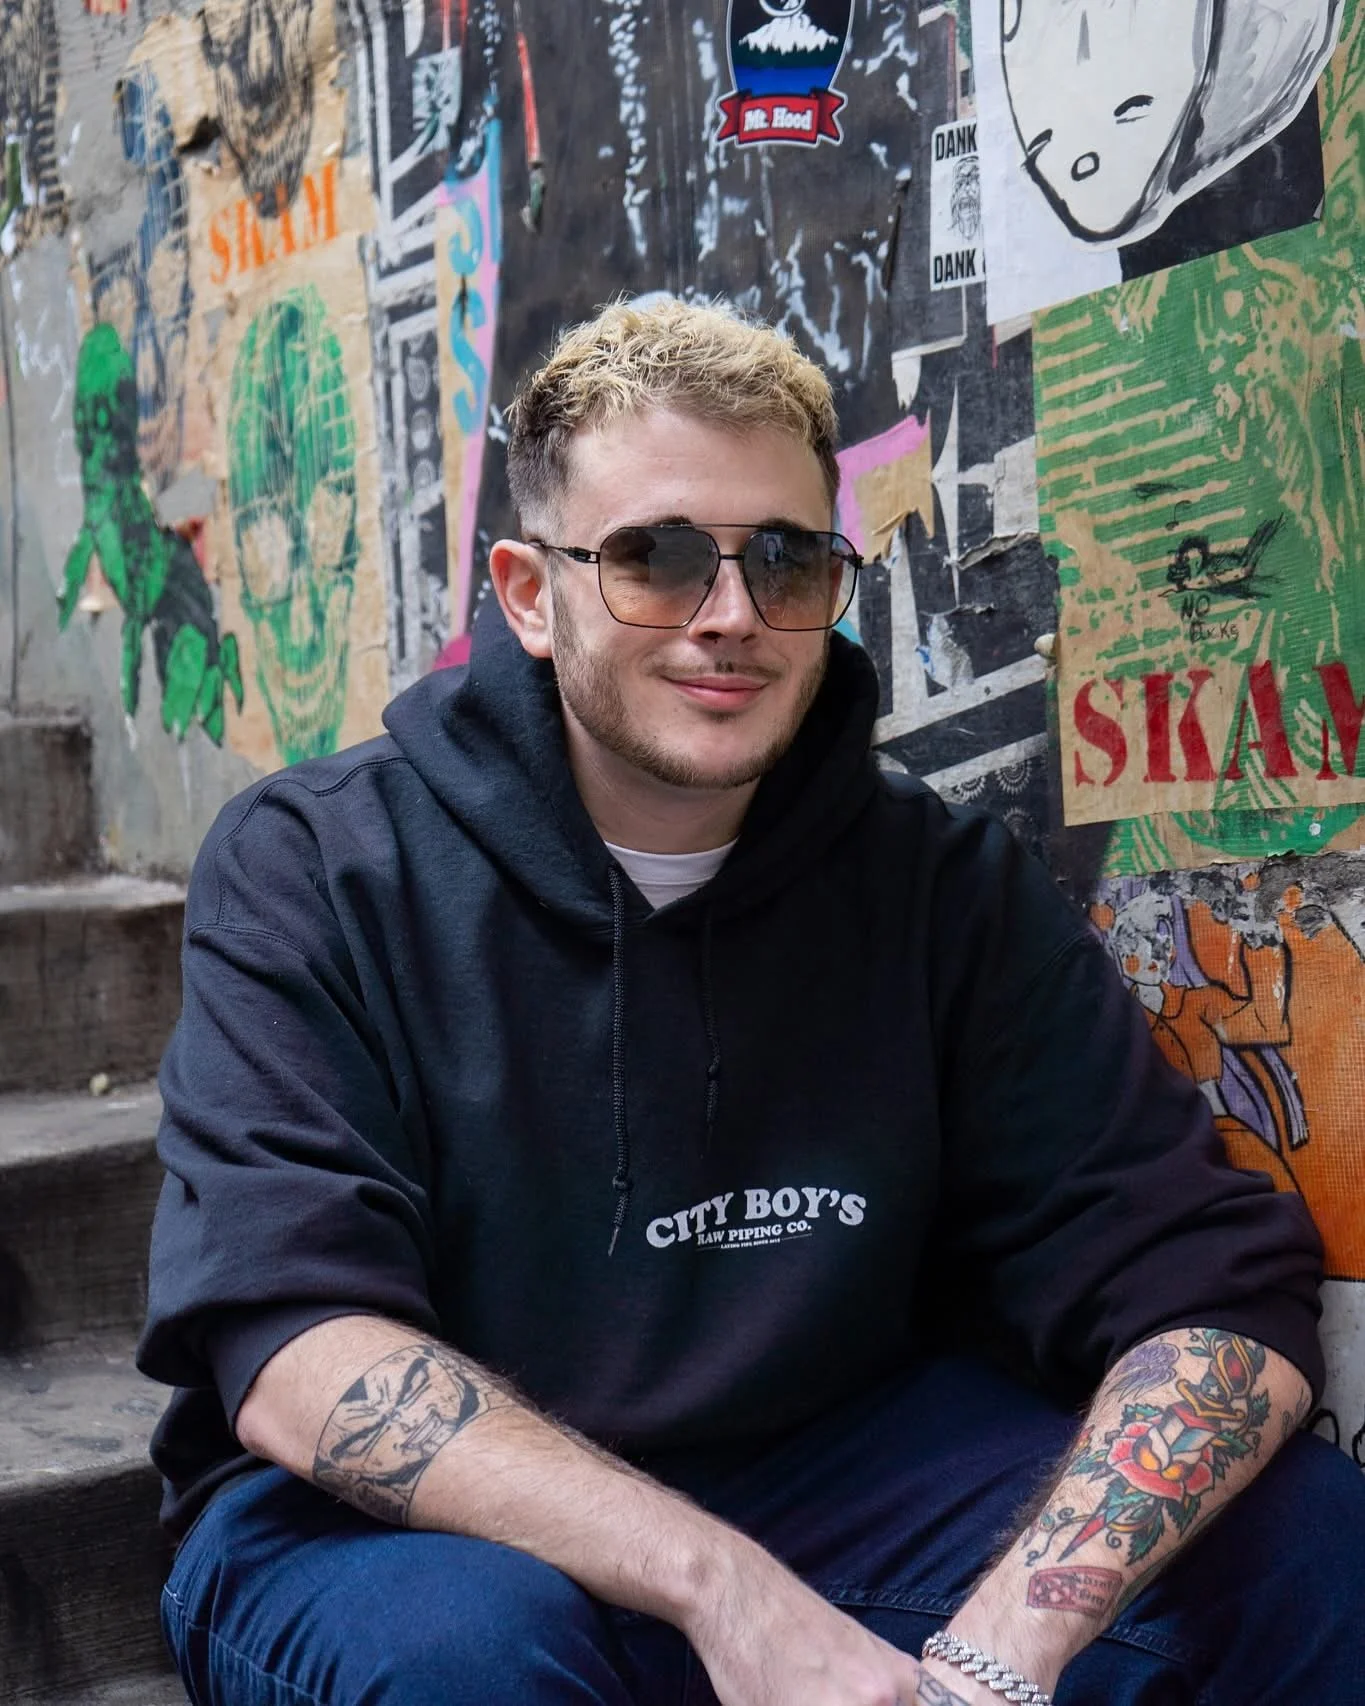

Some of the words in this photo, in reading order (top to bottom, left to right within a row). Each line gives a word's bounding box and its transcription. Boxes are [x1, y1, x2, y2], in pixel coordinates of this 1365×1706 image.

[771, 106, 813, 131] Hood
[935, 123, 977, 161] DANK
[934, 248, 976, 284] DANK
[645, 1191, 735, 1249] CITY
[744, 1186, 867, 1226] BOY'S
[697, 1230, 725, 1245] RAW
[727, 1223, 783, 1242] PIPING
[786, 1219, 812, 1234] CO.
